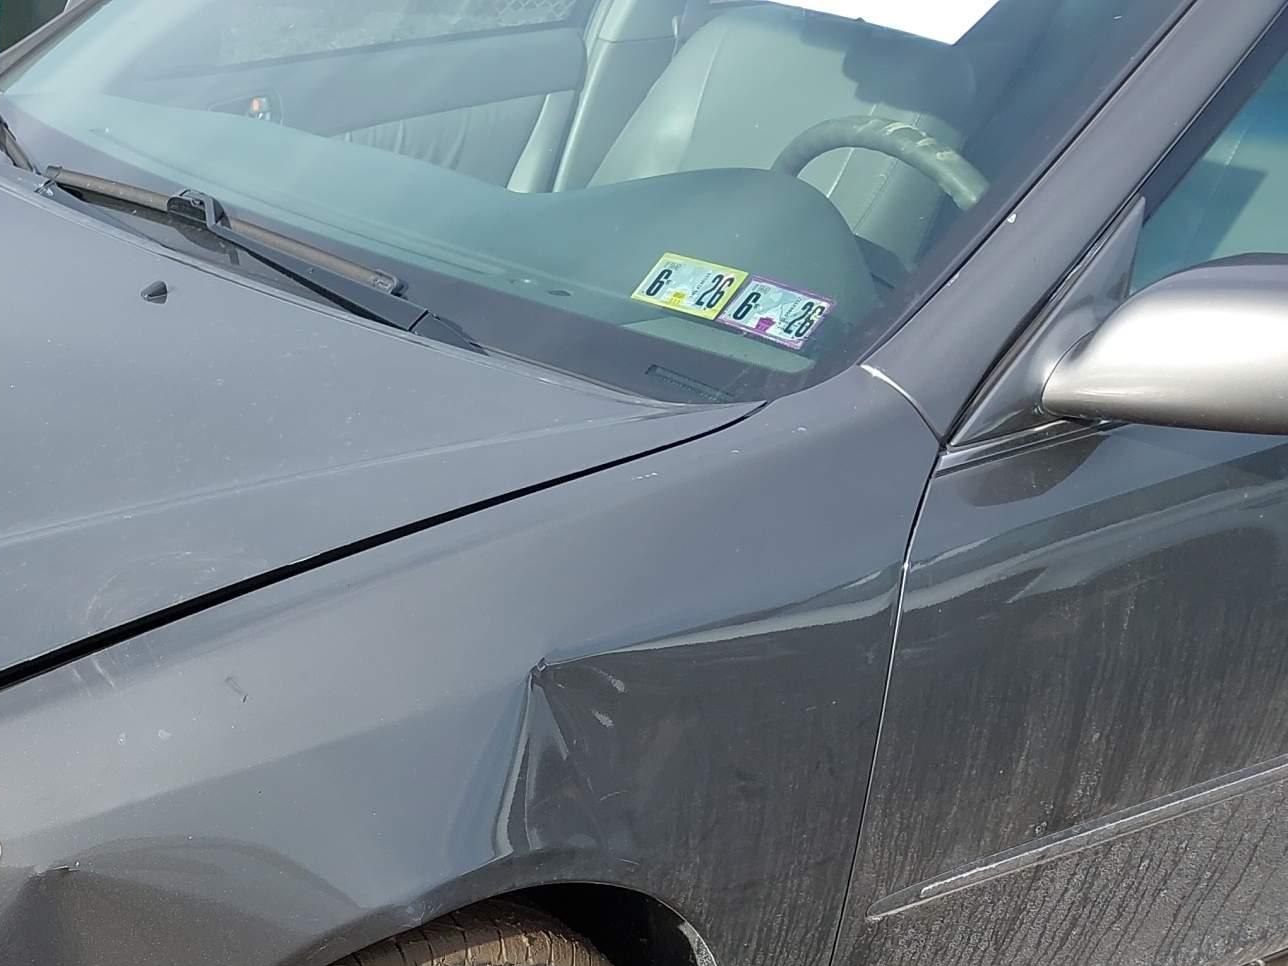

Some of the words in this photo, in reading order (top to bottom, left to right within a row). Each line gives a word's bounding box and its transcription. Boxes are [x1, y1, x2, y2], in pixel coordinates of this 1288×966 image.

[646, 268, 673, 297] 6
[695, 273, 736, 309] 26
[732, 291, 762, 321] 6
[783, 301, 826, 338] 26
